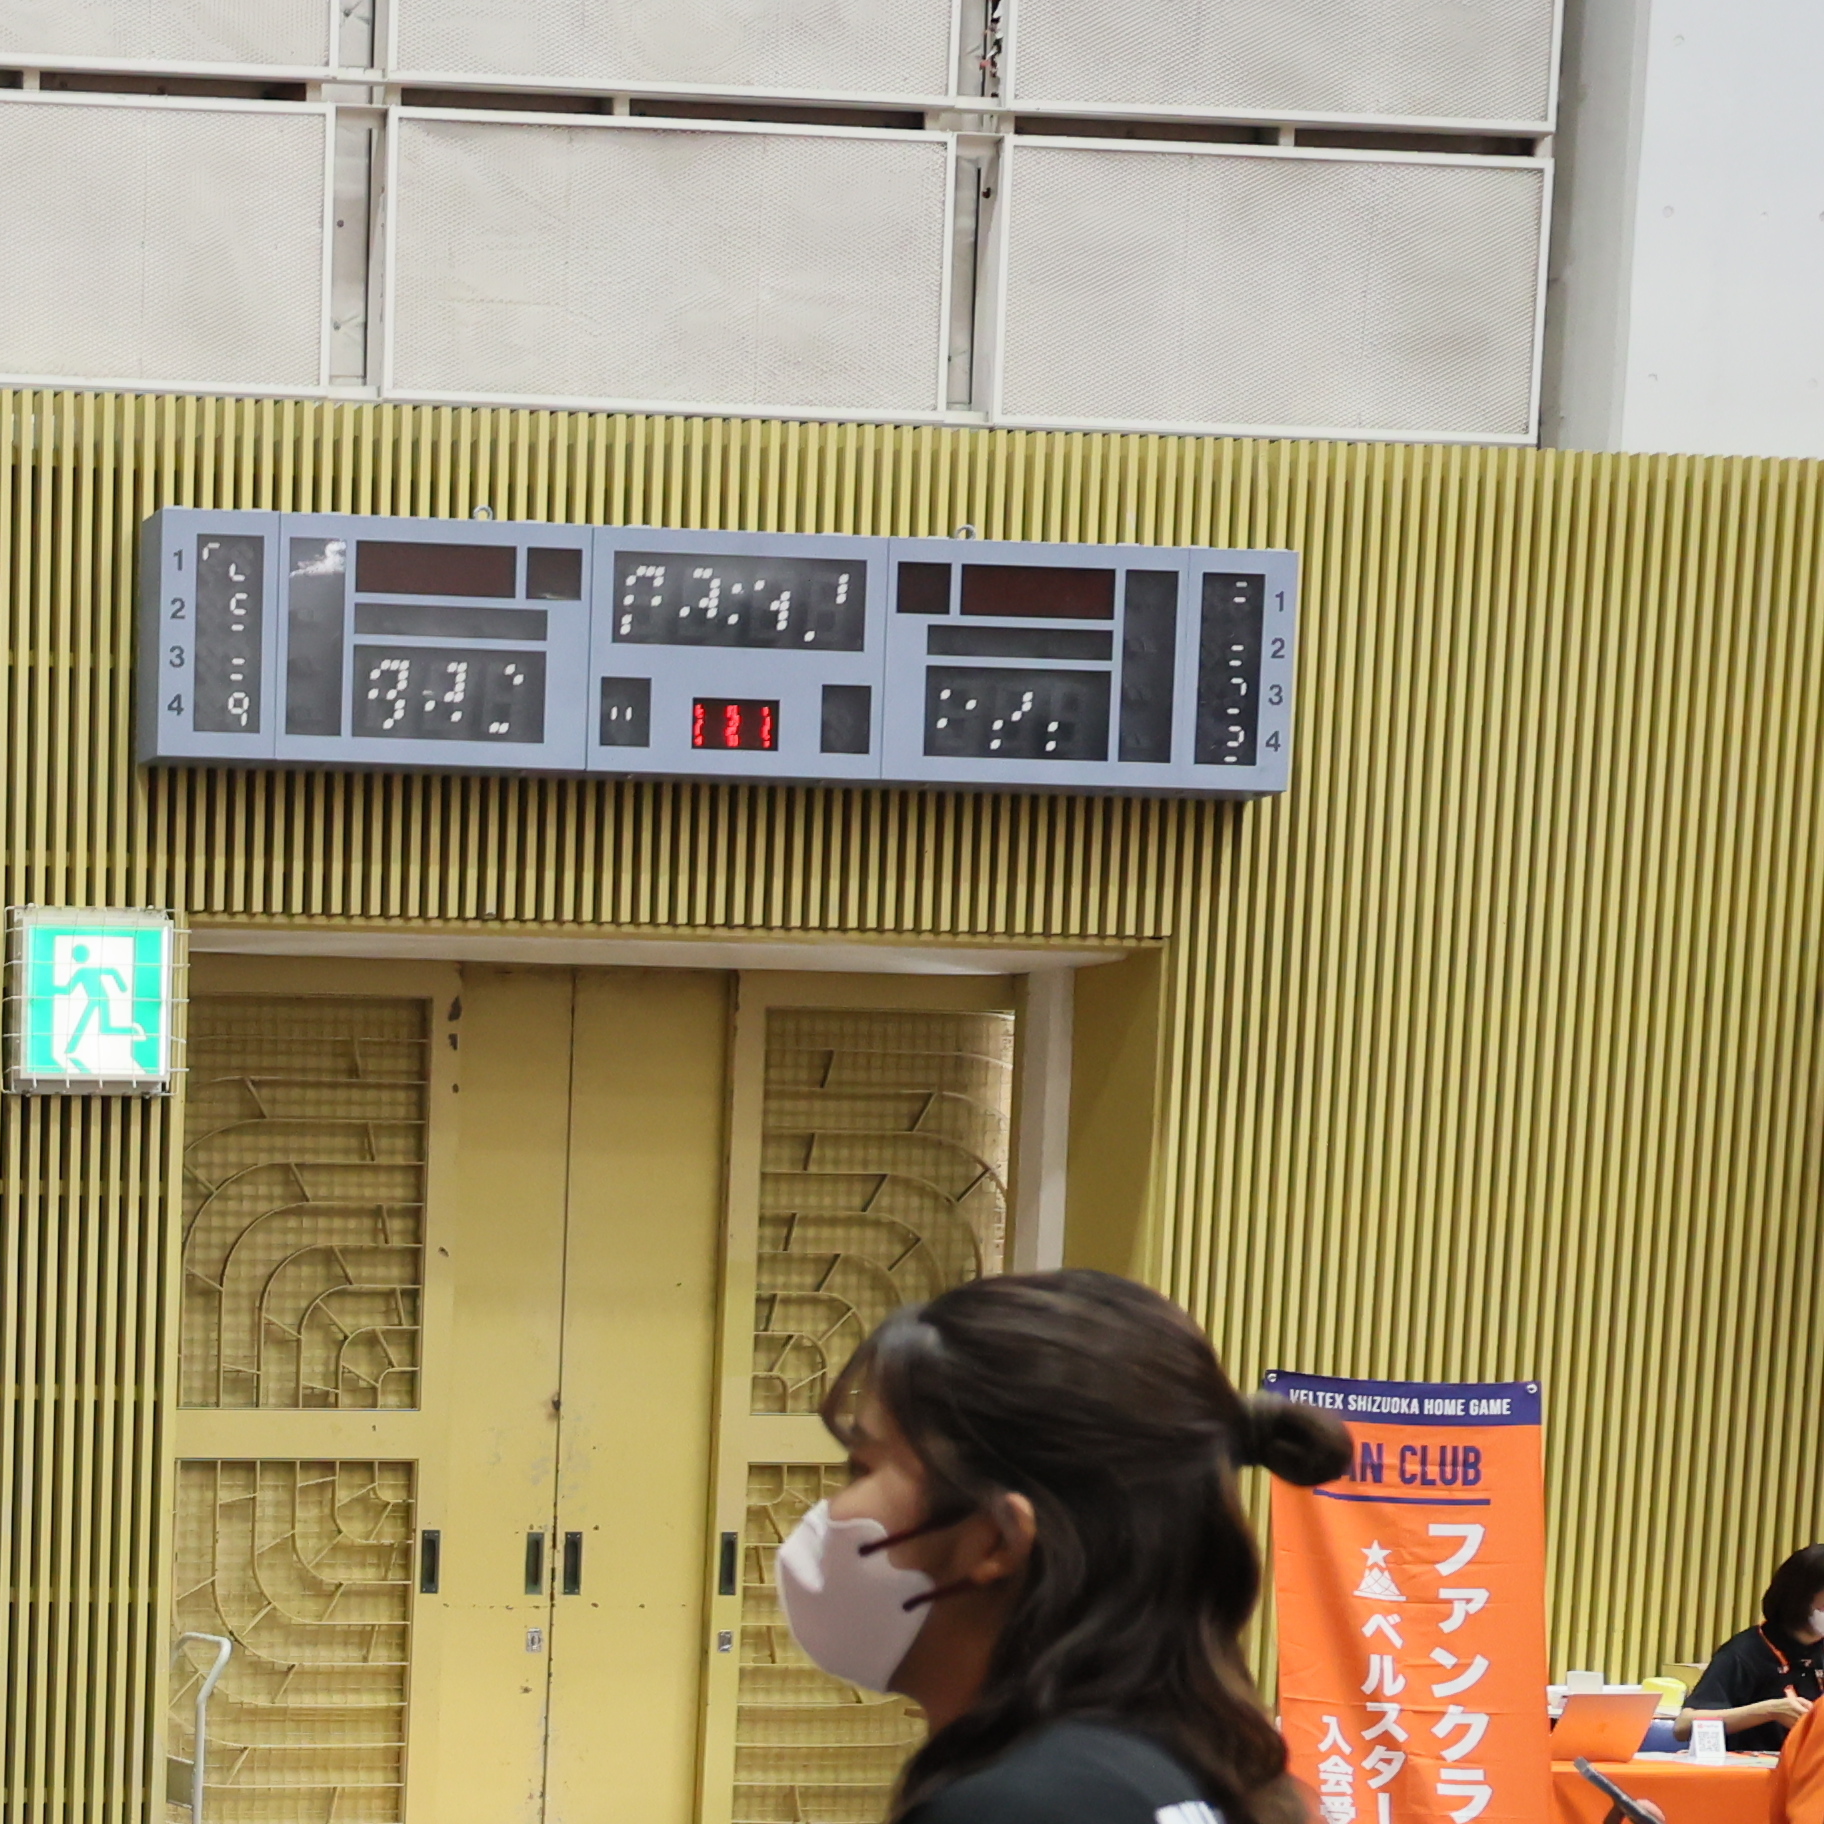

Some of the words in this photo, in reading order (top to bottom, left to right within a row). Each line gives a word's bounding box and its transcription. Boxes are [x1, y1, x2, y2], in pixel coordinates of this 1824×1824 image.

[173, 548, 185, 572] 1
[169, 598, 187, 621] 2
[1274, 590, 1285, 613] 1
[168, 645, 186, 668] 3
[1270, 637, 1286, 660] 2
[166, 694, 185, 717] 4
[1268, 684, 1284, 706] 3
[1264, 731, 1281, 753] 4
[1348, 1394, 1420, 1416] SHIZUOKA
[1424, 1398, 1466, 1416] HOME
[1469, 1398, 1512, 1416] GAME
[1399, 1445, 1482, 1487] CLUB
